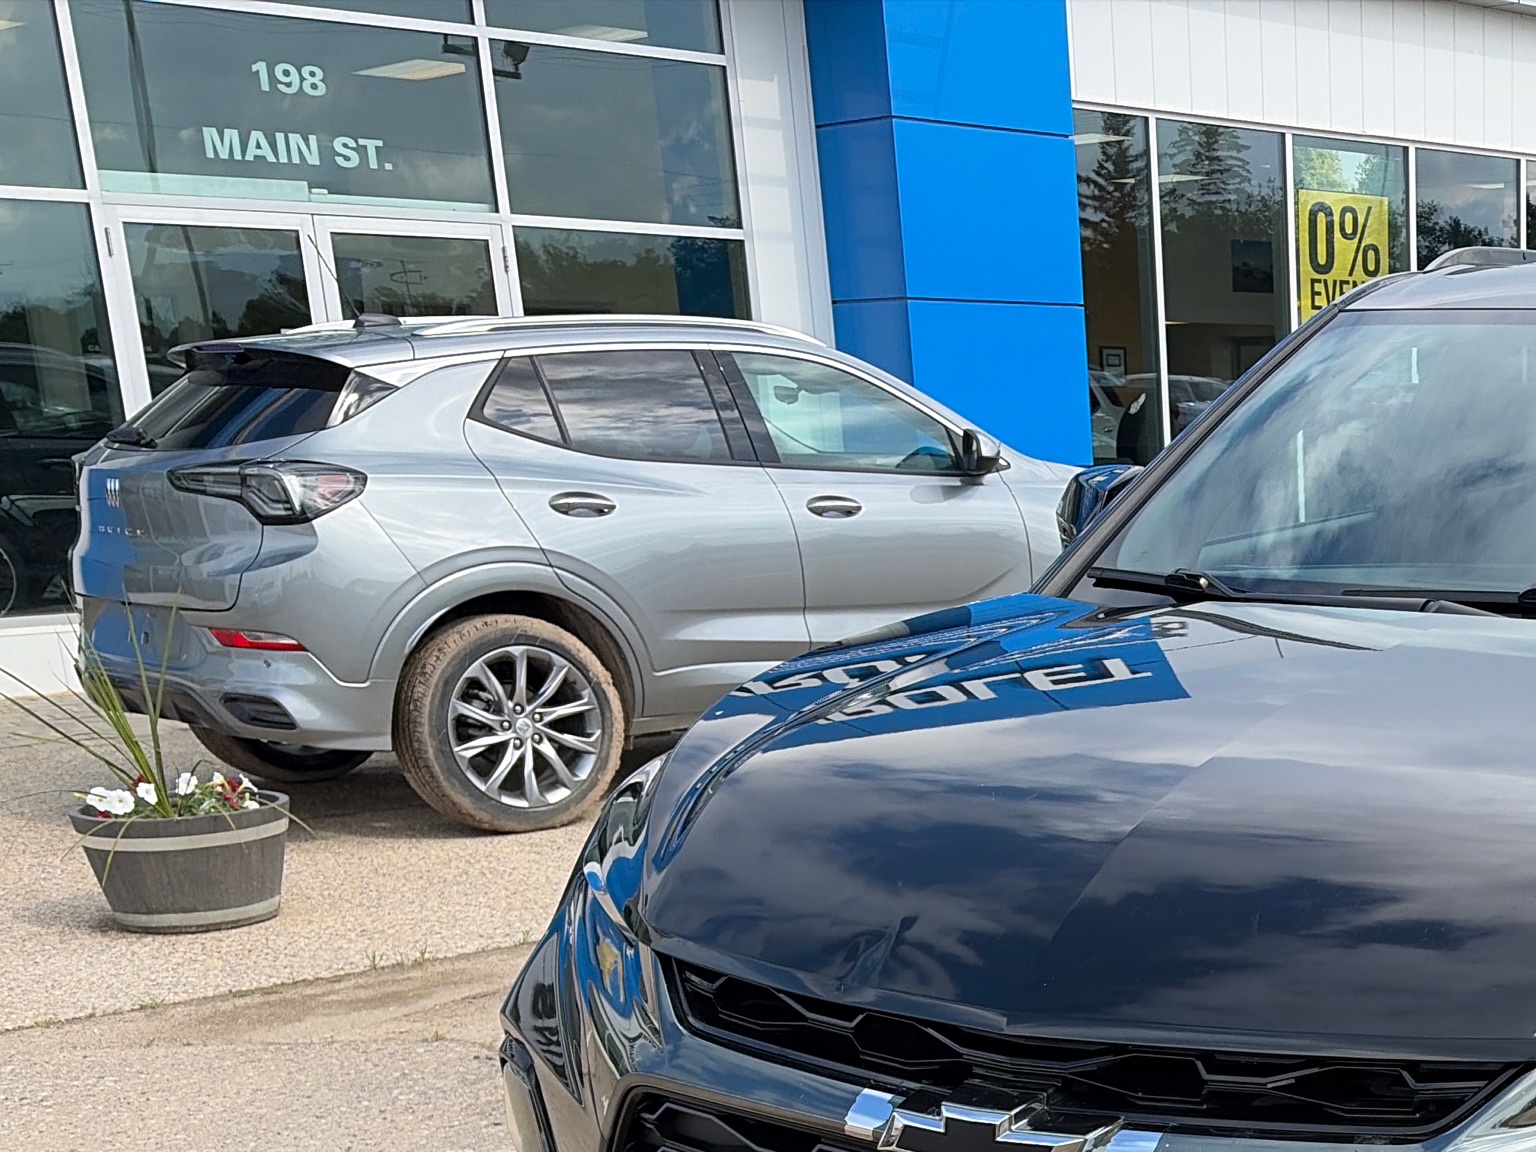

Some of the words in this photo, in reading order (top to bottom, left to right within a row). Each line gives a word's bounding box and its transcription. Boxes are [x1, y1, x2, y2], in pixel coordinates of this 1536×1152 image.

[251, 61, 327, 97] 198
[201, 126, 321, 166] MAIN
[332, 136, 394, 171] ST.
[1308, 201, 1381, 278] 0%
[1310, 278, 1364, 311] EVE
